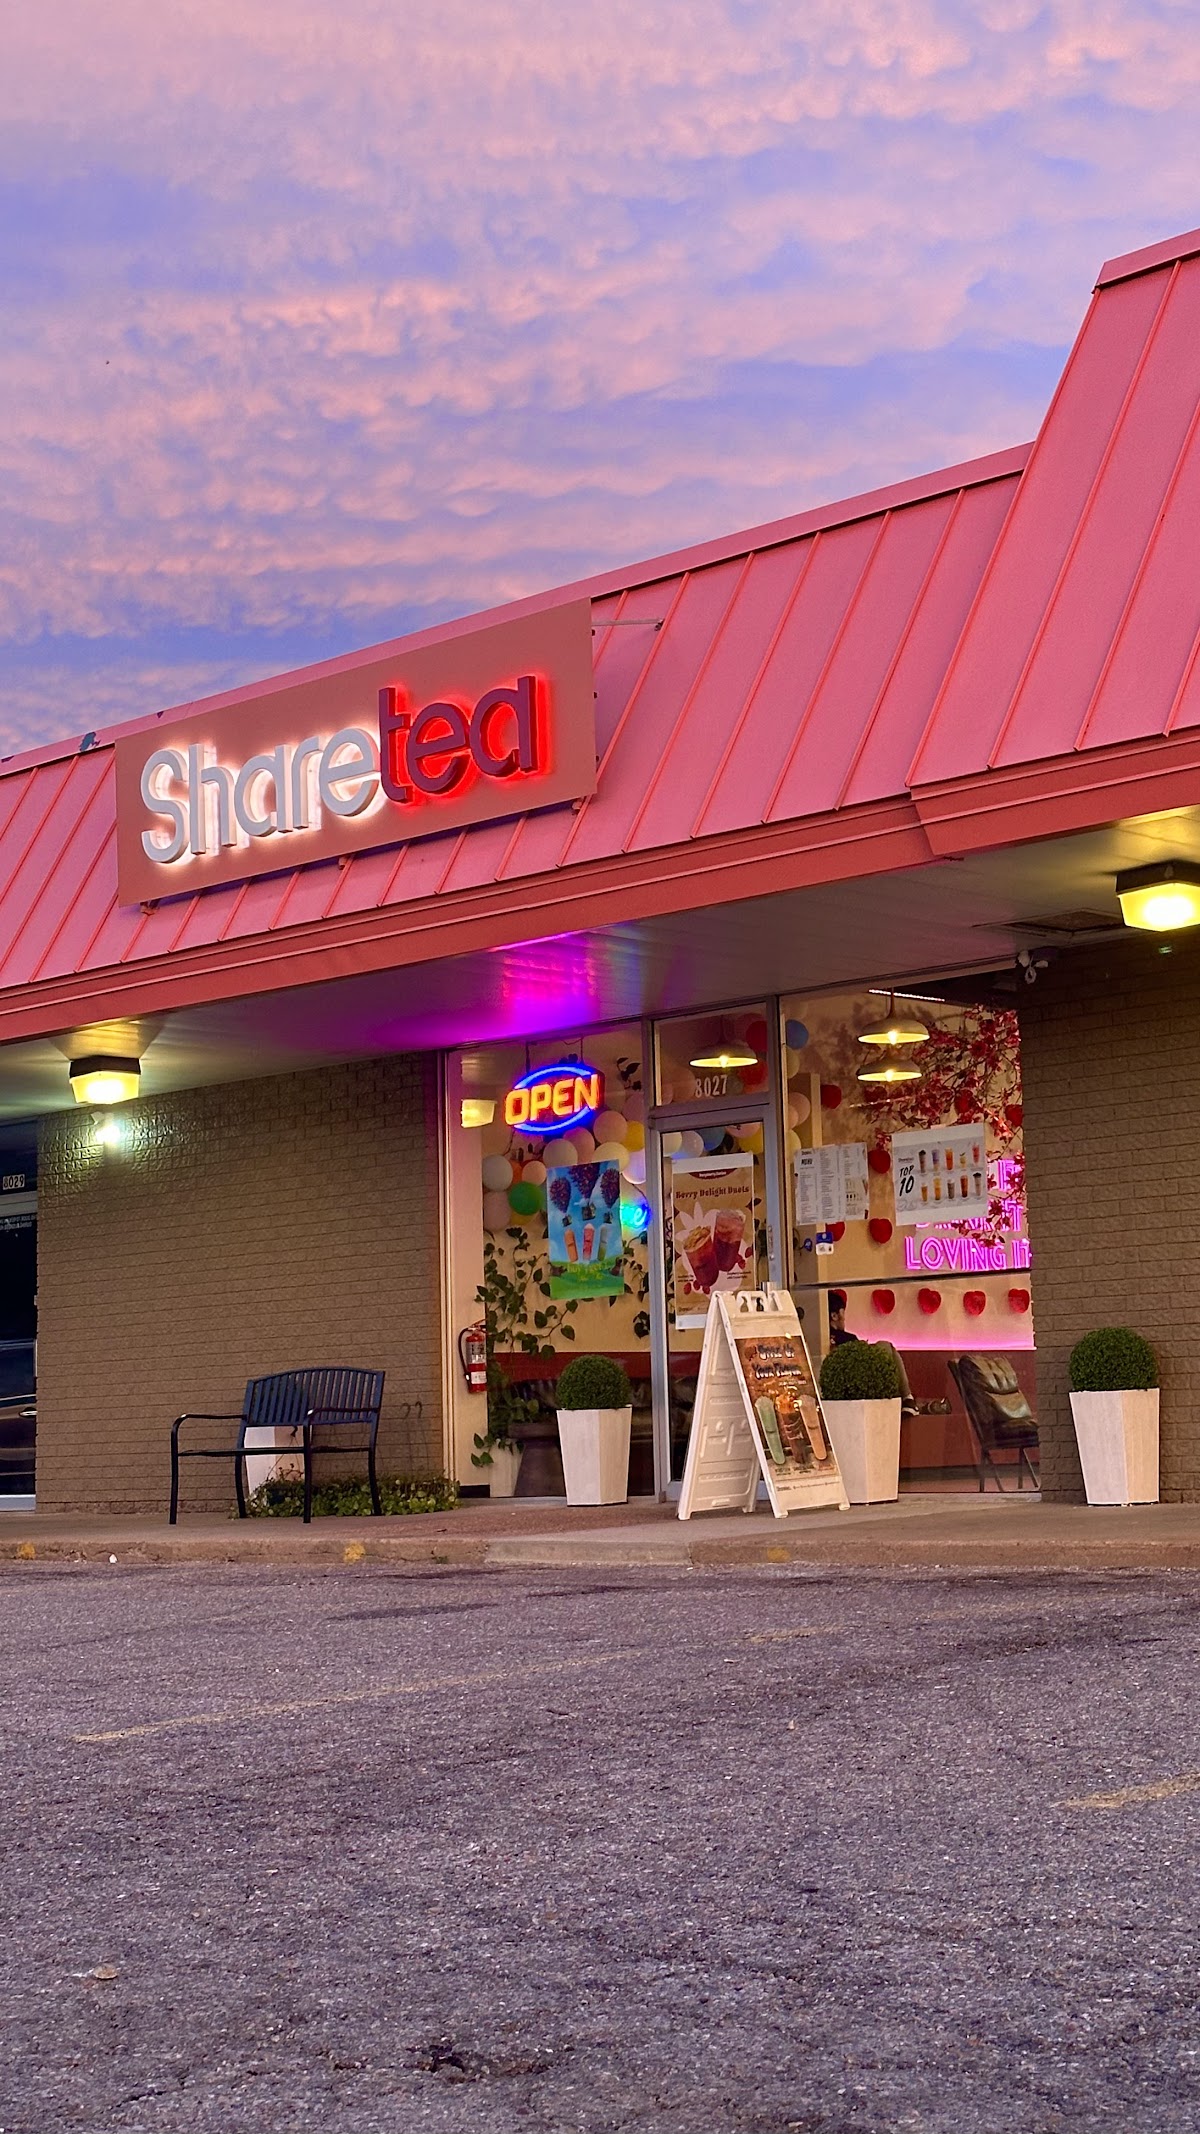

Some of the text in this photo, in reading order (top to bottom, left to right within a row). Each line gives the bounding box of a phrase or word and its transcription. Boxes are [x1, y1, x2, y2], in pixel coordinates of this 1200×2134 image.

[140, 674, 538, 864] Sharetea
[695, 1075, 727, 1098] 8027
[505, 1074, 599, 1126] OPEN
[3, 1175, 24, 1188] 8029
[900, 1165, 914, 1177] TOP
[699, 1187, 726, 1197] Delight
[899, 1175, 914, 1196] 10
[905, 1236, 1007, 1270] LOVING
